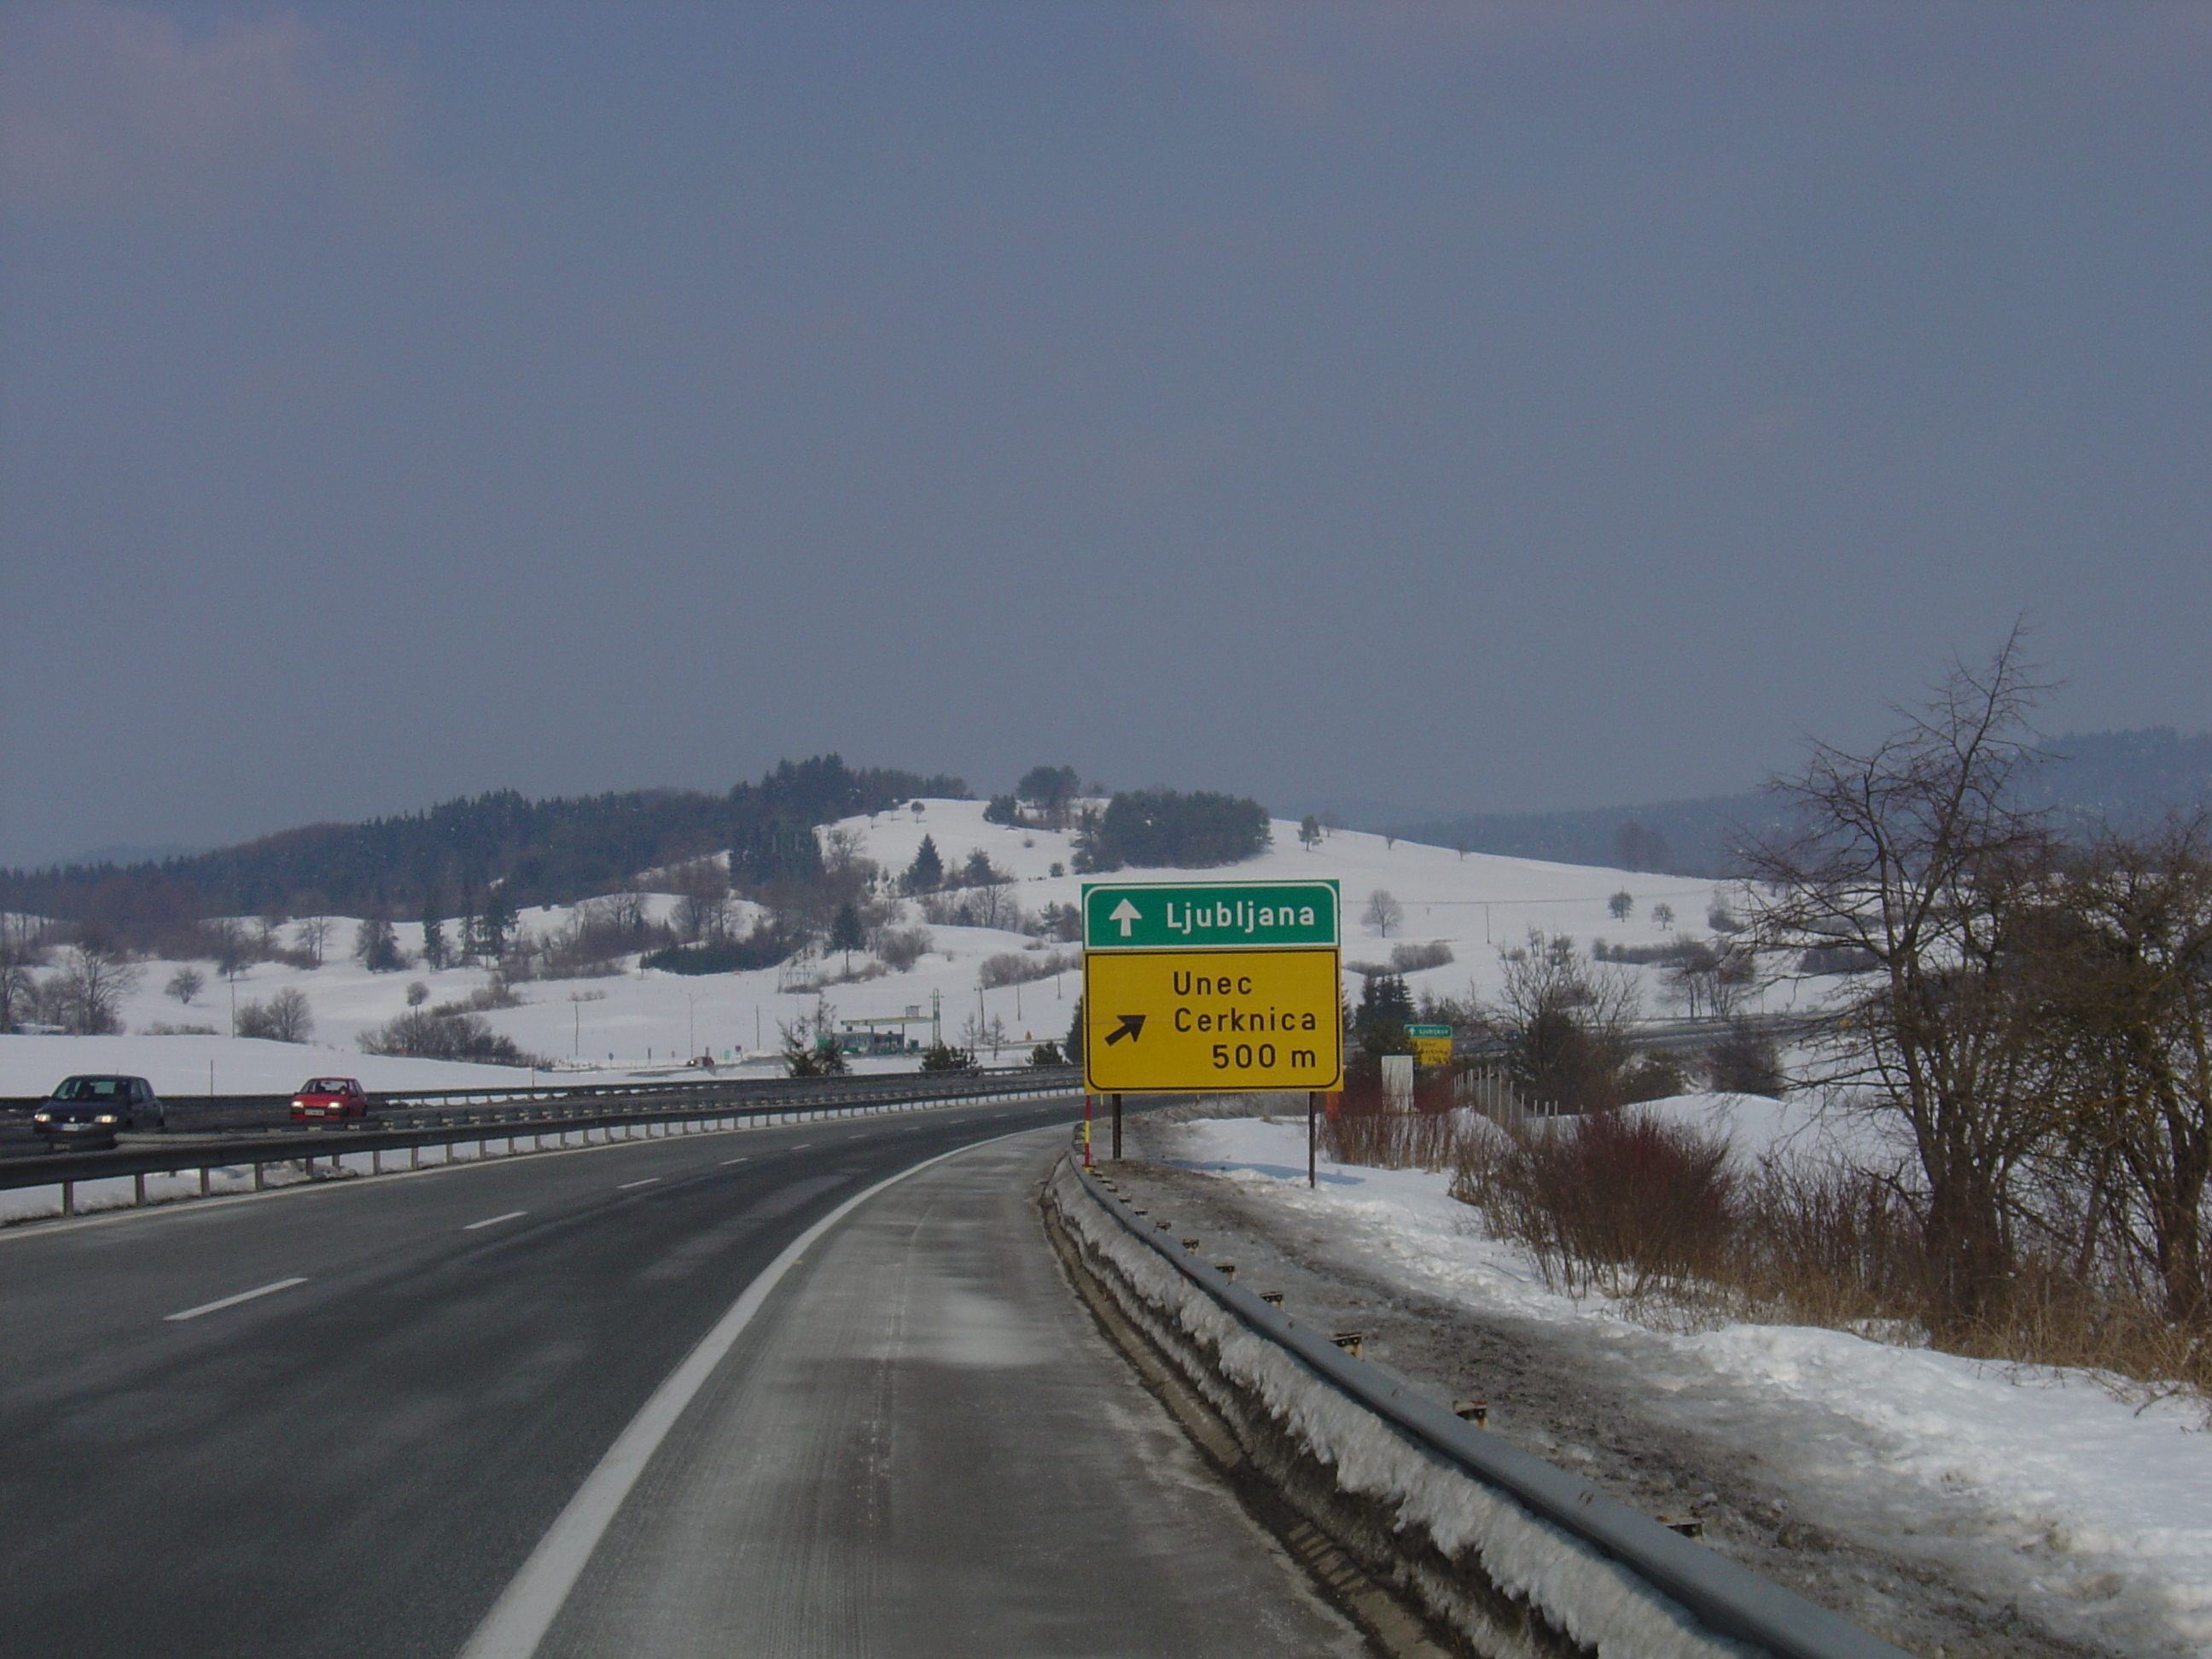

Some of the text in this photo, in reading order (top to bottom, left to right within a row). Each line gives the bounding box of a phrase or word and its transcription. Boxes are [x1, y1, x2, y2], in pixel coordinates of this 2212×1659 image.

[1167, 901, 1315, 934] Ljubljana
[1173, 971, 1252, 996] Unec
[1174, 1007, 1316, 1033] Cerknica
[1213, 1044, 1316, 1068] 500 m
